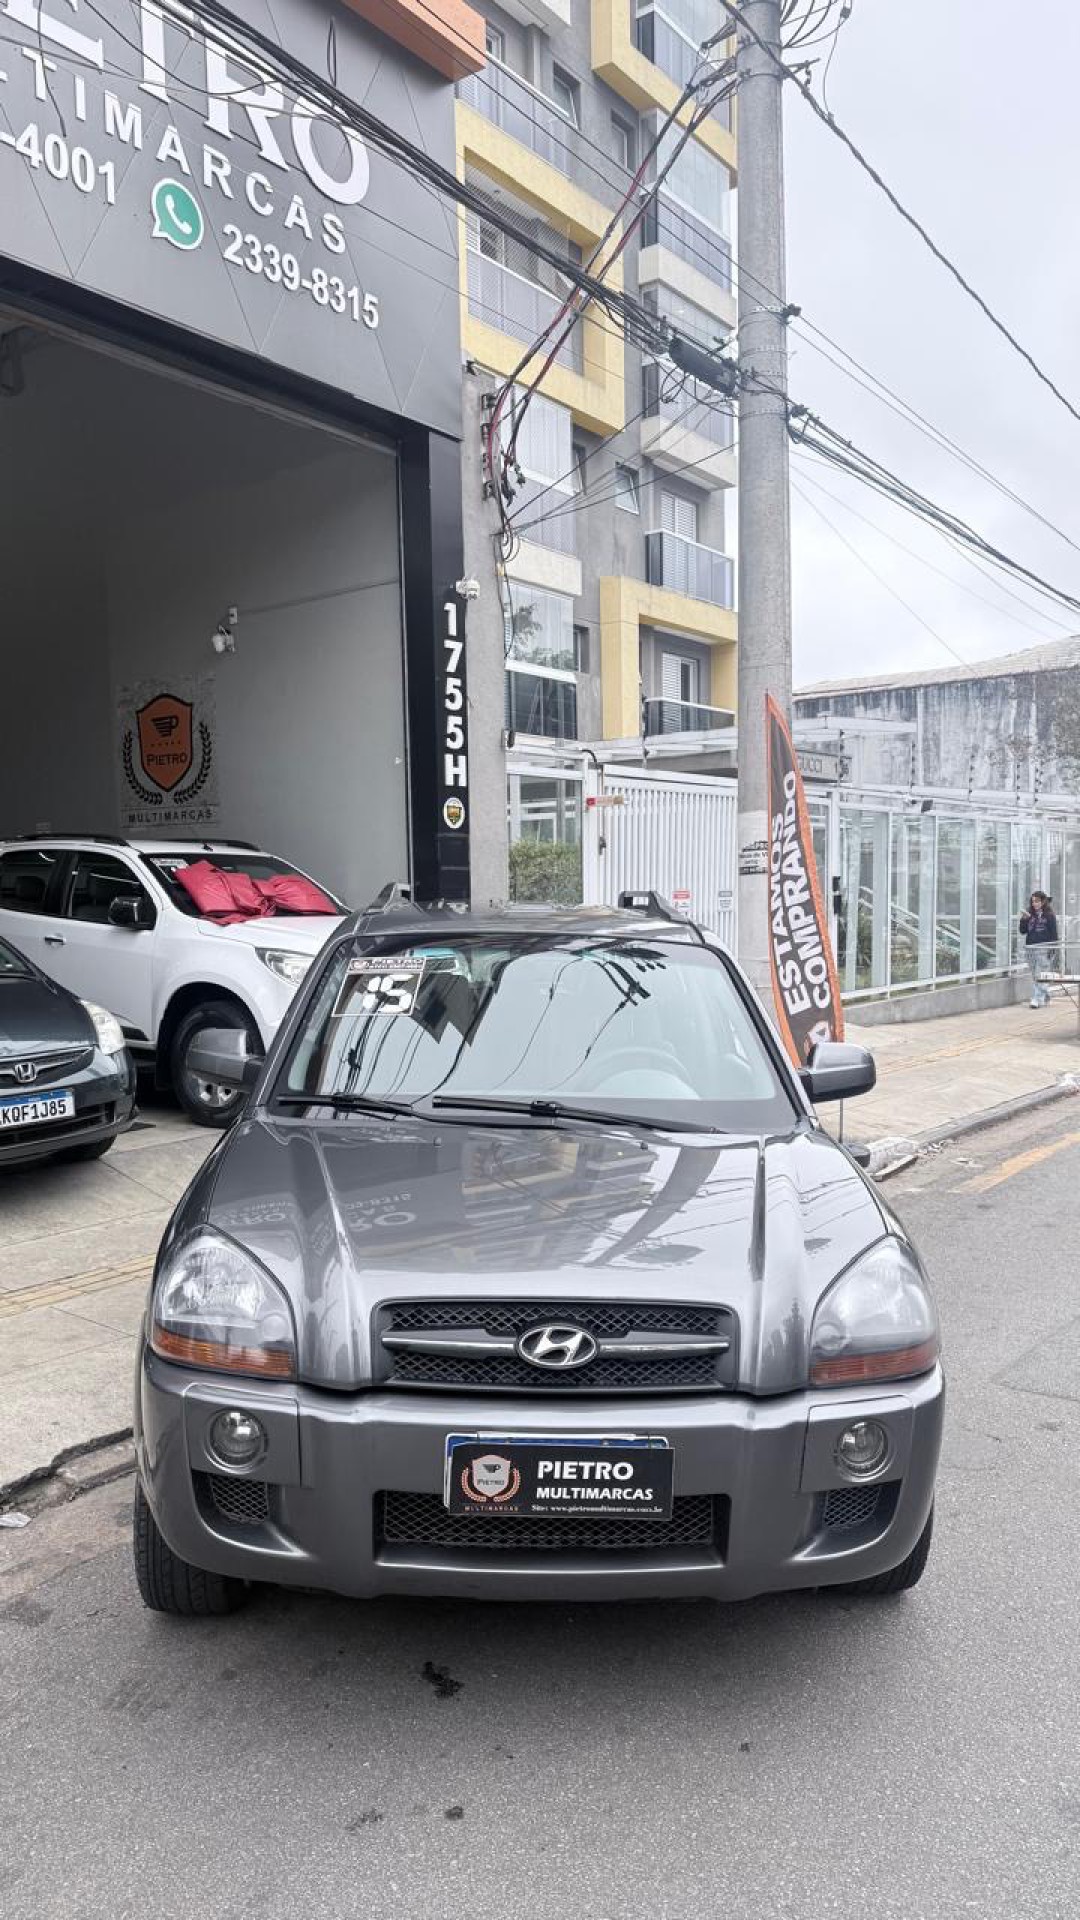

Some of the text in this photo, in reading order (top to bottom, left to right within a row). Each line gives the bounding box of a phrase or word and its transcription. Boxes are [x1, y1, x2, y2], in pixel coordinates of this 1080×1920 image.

[0, 47, 347, 254] TIMARCAS
[221, 224, 380, 329] 2339-8315
[443, 602, 467, 787] 1755H
[146, 752, 188, 767] PIETRO
[128, 808, 213, 823] MULTIMARCAS
[782, 770, 832, 1010] COMPRANDO
[771, 812, 811, 1015] ESTAMOS
[362, 973, 415, 1013] 15
[1, 1099, 67, 1125] KQF1J85
[536, 1460, 634, 1481] PIETRO
[536, 1486, 654, 1501] MULTIMARCAS
